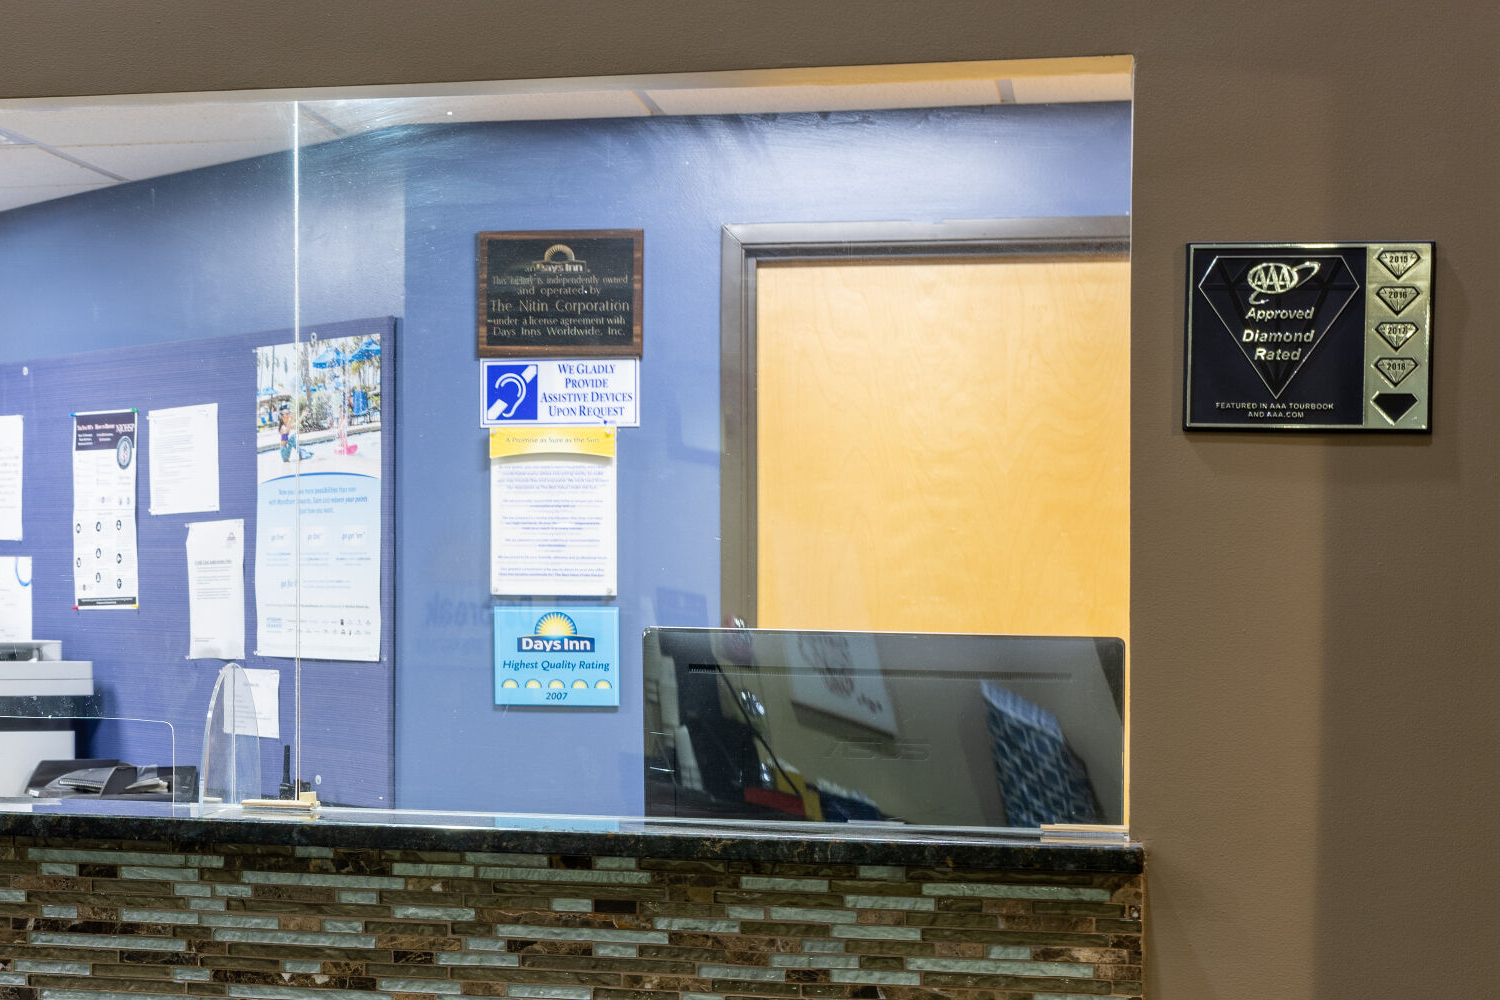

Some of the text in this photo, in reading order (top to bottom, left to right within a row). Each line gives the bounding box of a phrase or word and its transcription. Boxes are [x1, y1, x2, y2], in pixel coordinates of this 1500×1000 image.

[1389, 255, 1408, 264] 2015
[565, 263, 583, 272] Inn
[546, 275, 599, 285] independently
[602, 275, 628, 283] owned
[518, 286, 601, 297] and operated by
[1388, 291, 1407, 299] 2016
[490, 300, 629, 314] The Nitin Corporation
[1245, 307, 1315, 321] Approved
[493, 316, 518, 325] under
[529, 316, 558, 325] license
[559, 316, 604, 328] agreement
[607, 316, 625, 324] with
[492, 327, 625, 336] Days Inns Worldwide, Inc.
[1242, 329, 1315, 344] Diamond
[1387, 327, 1407, 335] 2017
[1254, 348, 1302, 361] Rated
[558, 363, 616, 374] WE GLADLY
[1387, 363, 1406, 371] 2018
[565, 378, 608, 388] PROVIDE
[540, 392, 633, 403] ASSISTIVE DEVICES
[548, 406, 625, 419] UPON REQUEST
[522, 638, 591, 651] Days Inn
[503, 660, 609, 671] Highest Quality Rating
